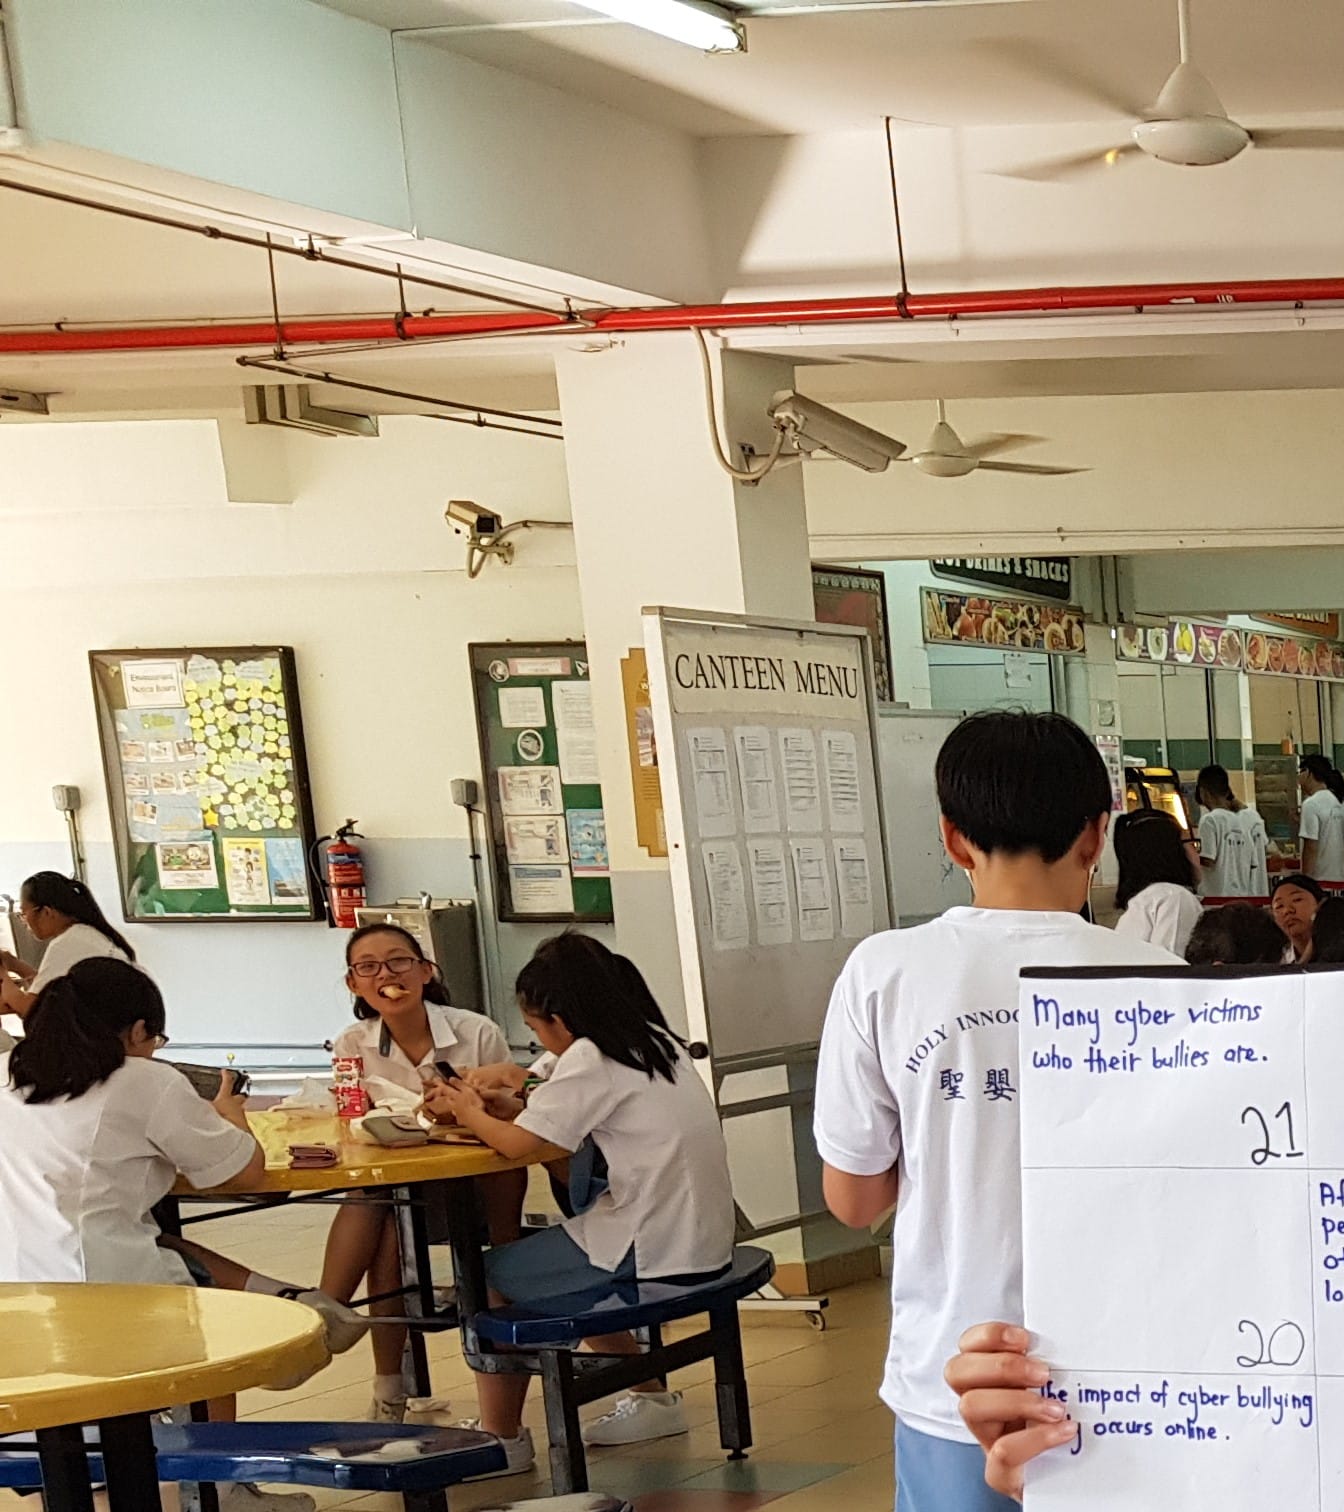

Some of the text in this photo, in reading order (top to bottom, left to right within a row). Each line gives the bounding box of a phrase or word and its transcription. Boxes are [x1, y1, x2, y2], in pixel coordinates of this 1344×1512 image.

[1025, 558, 1069, 584] SNACKS
[675, 652, 859, 700] CANTEEN MENU
[1032, 994, 1262, 1045] Many cyber victims
[904, 1023, 950, 1075] HOLY
[1032, 1040, 1210, 1075] who their bullies
[1240, 1100, 1304, 1166] 21
[1235, 1318, 1306, 1369] 20
[1078, 1380, 1313, 1428] impact of cyber bullying
[1093, 1420, 1154, 1436] occurs
